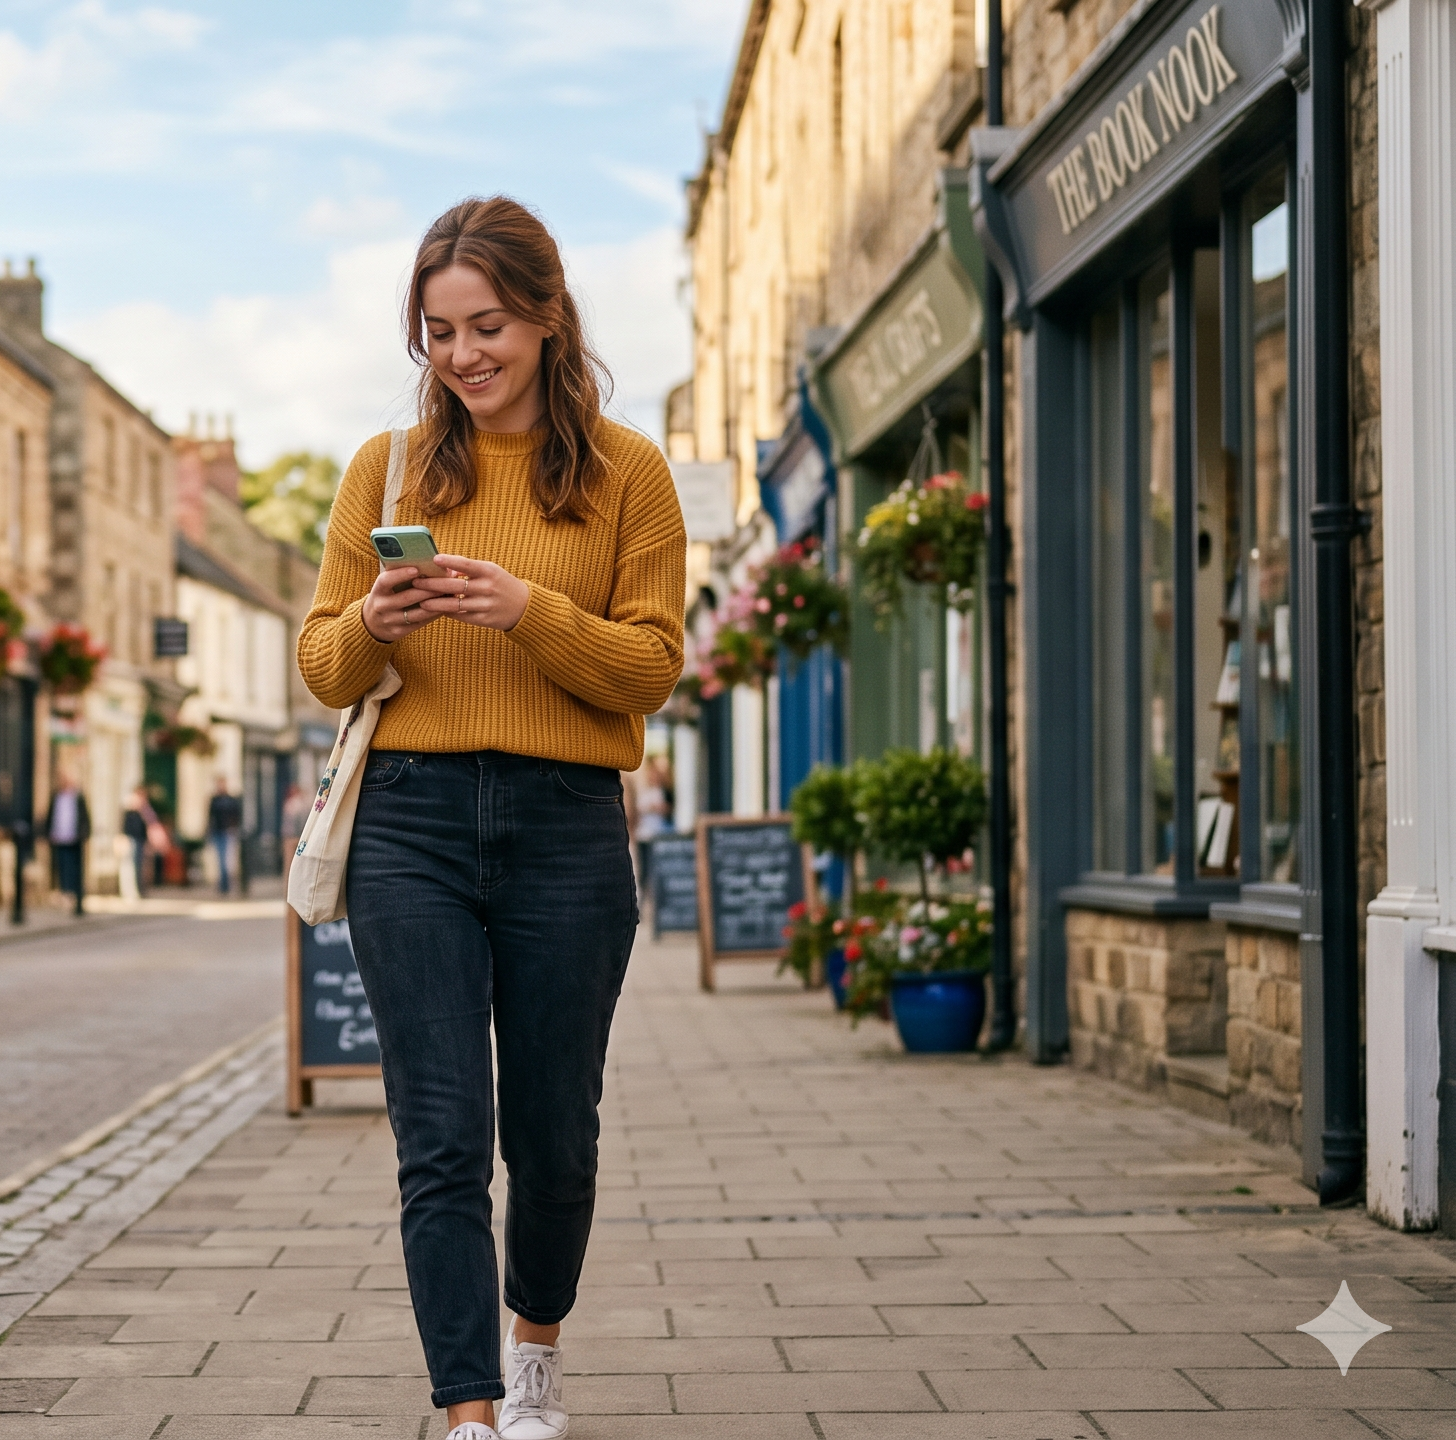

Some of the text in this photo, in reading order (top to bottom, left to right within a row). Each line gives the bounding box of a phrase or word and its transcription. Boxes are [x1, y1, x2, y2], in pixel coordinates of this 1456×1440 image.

[1046, 3, 1238, 236] THE BOOK NOOK
